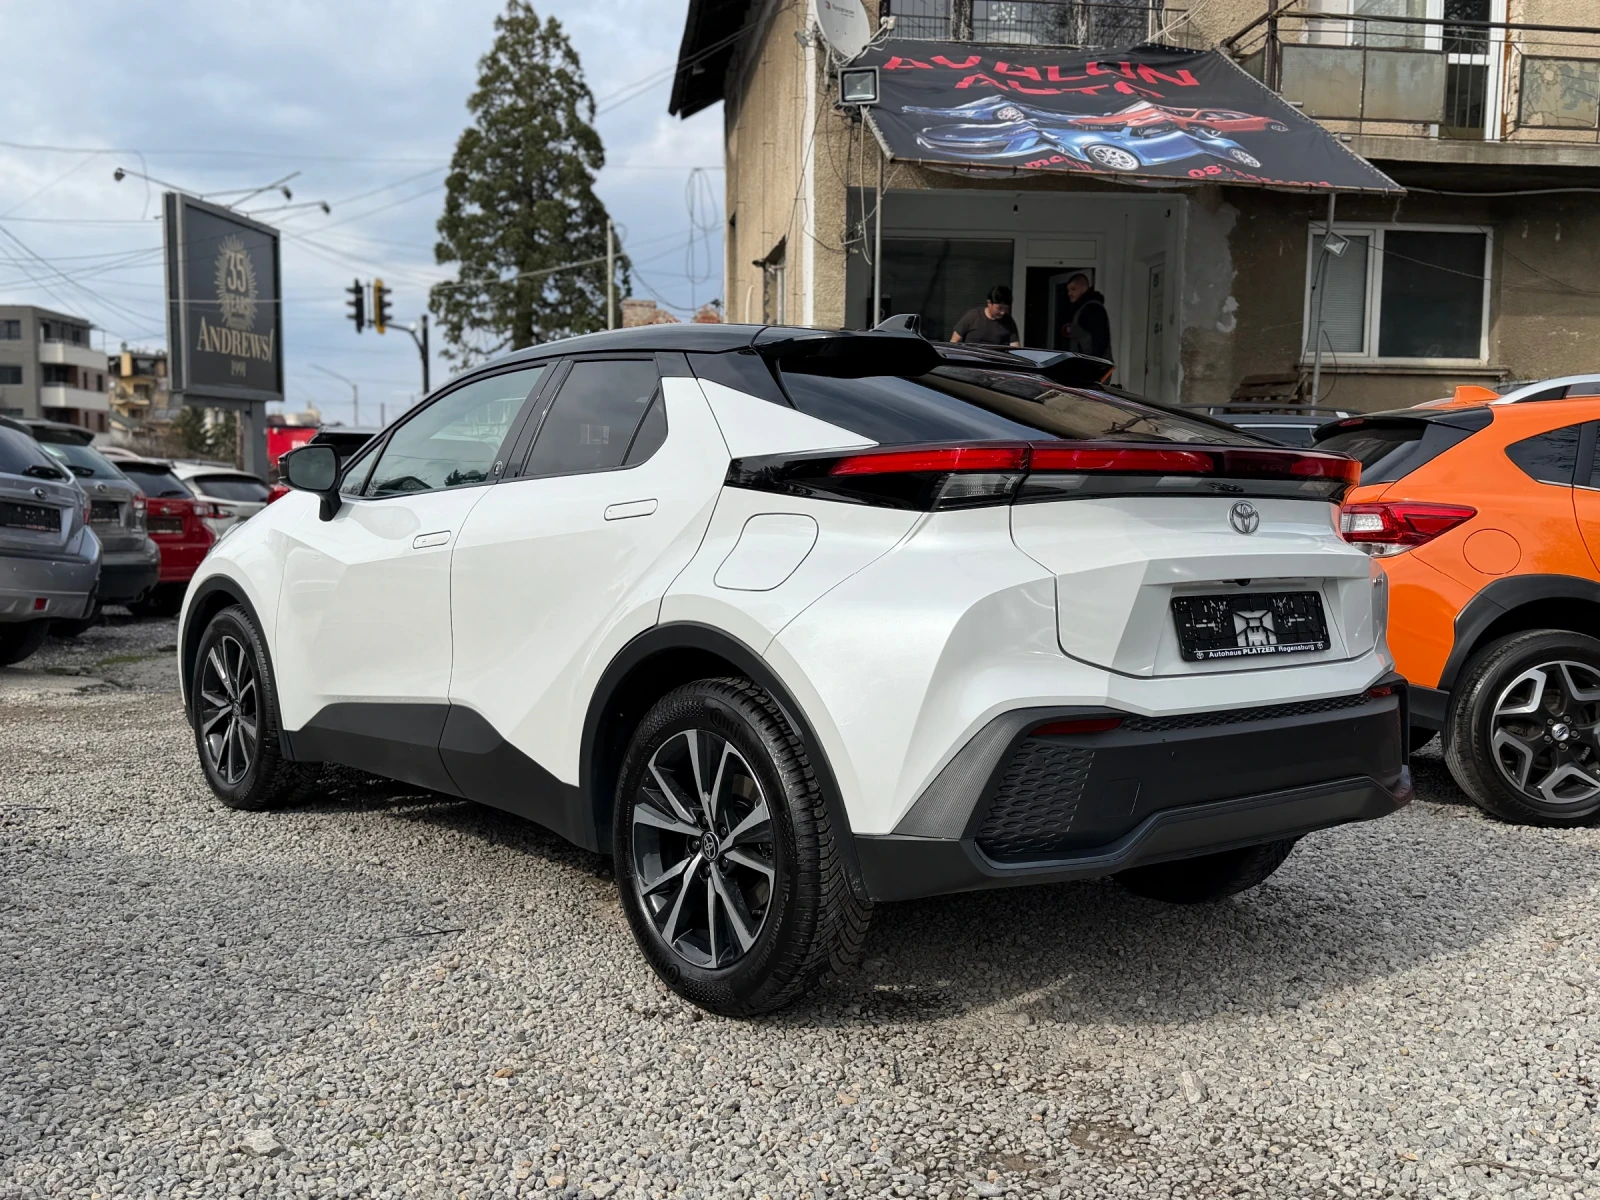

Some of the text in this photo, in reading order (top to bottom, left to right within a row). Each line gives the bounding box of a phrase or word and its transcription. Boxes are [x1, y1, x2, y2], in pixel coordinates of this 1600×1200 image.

[226, 250, 247, 293] 35
[1209, 644, 1315, 658] Autohaus PLATZER Regensburg
